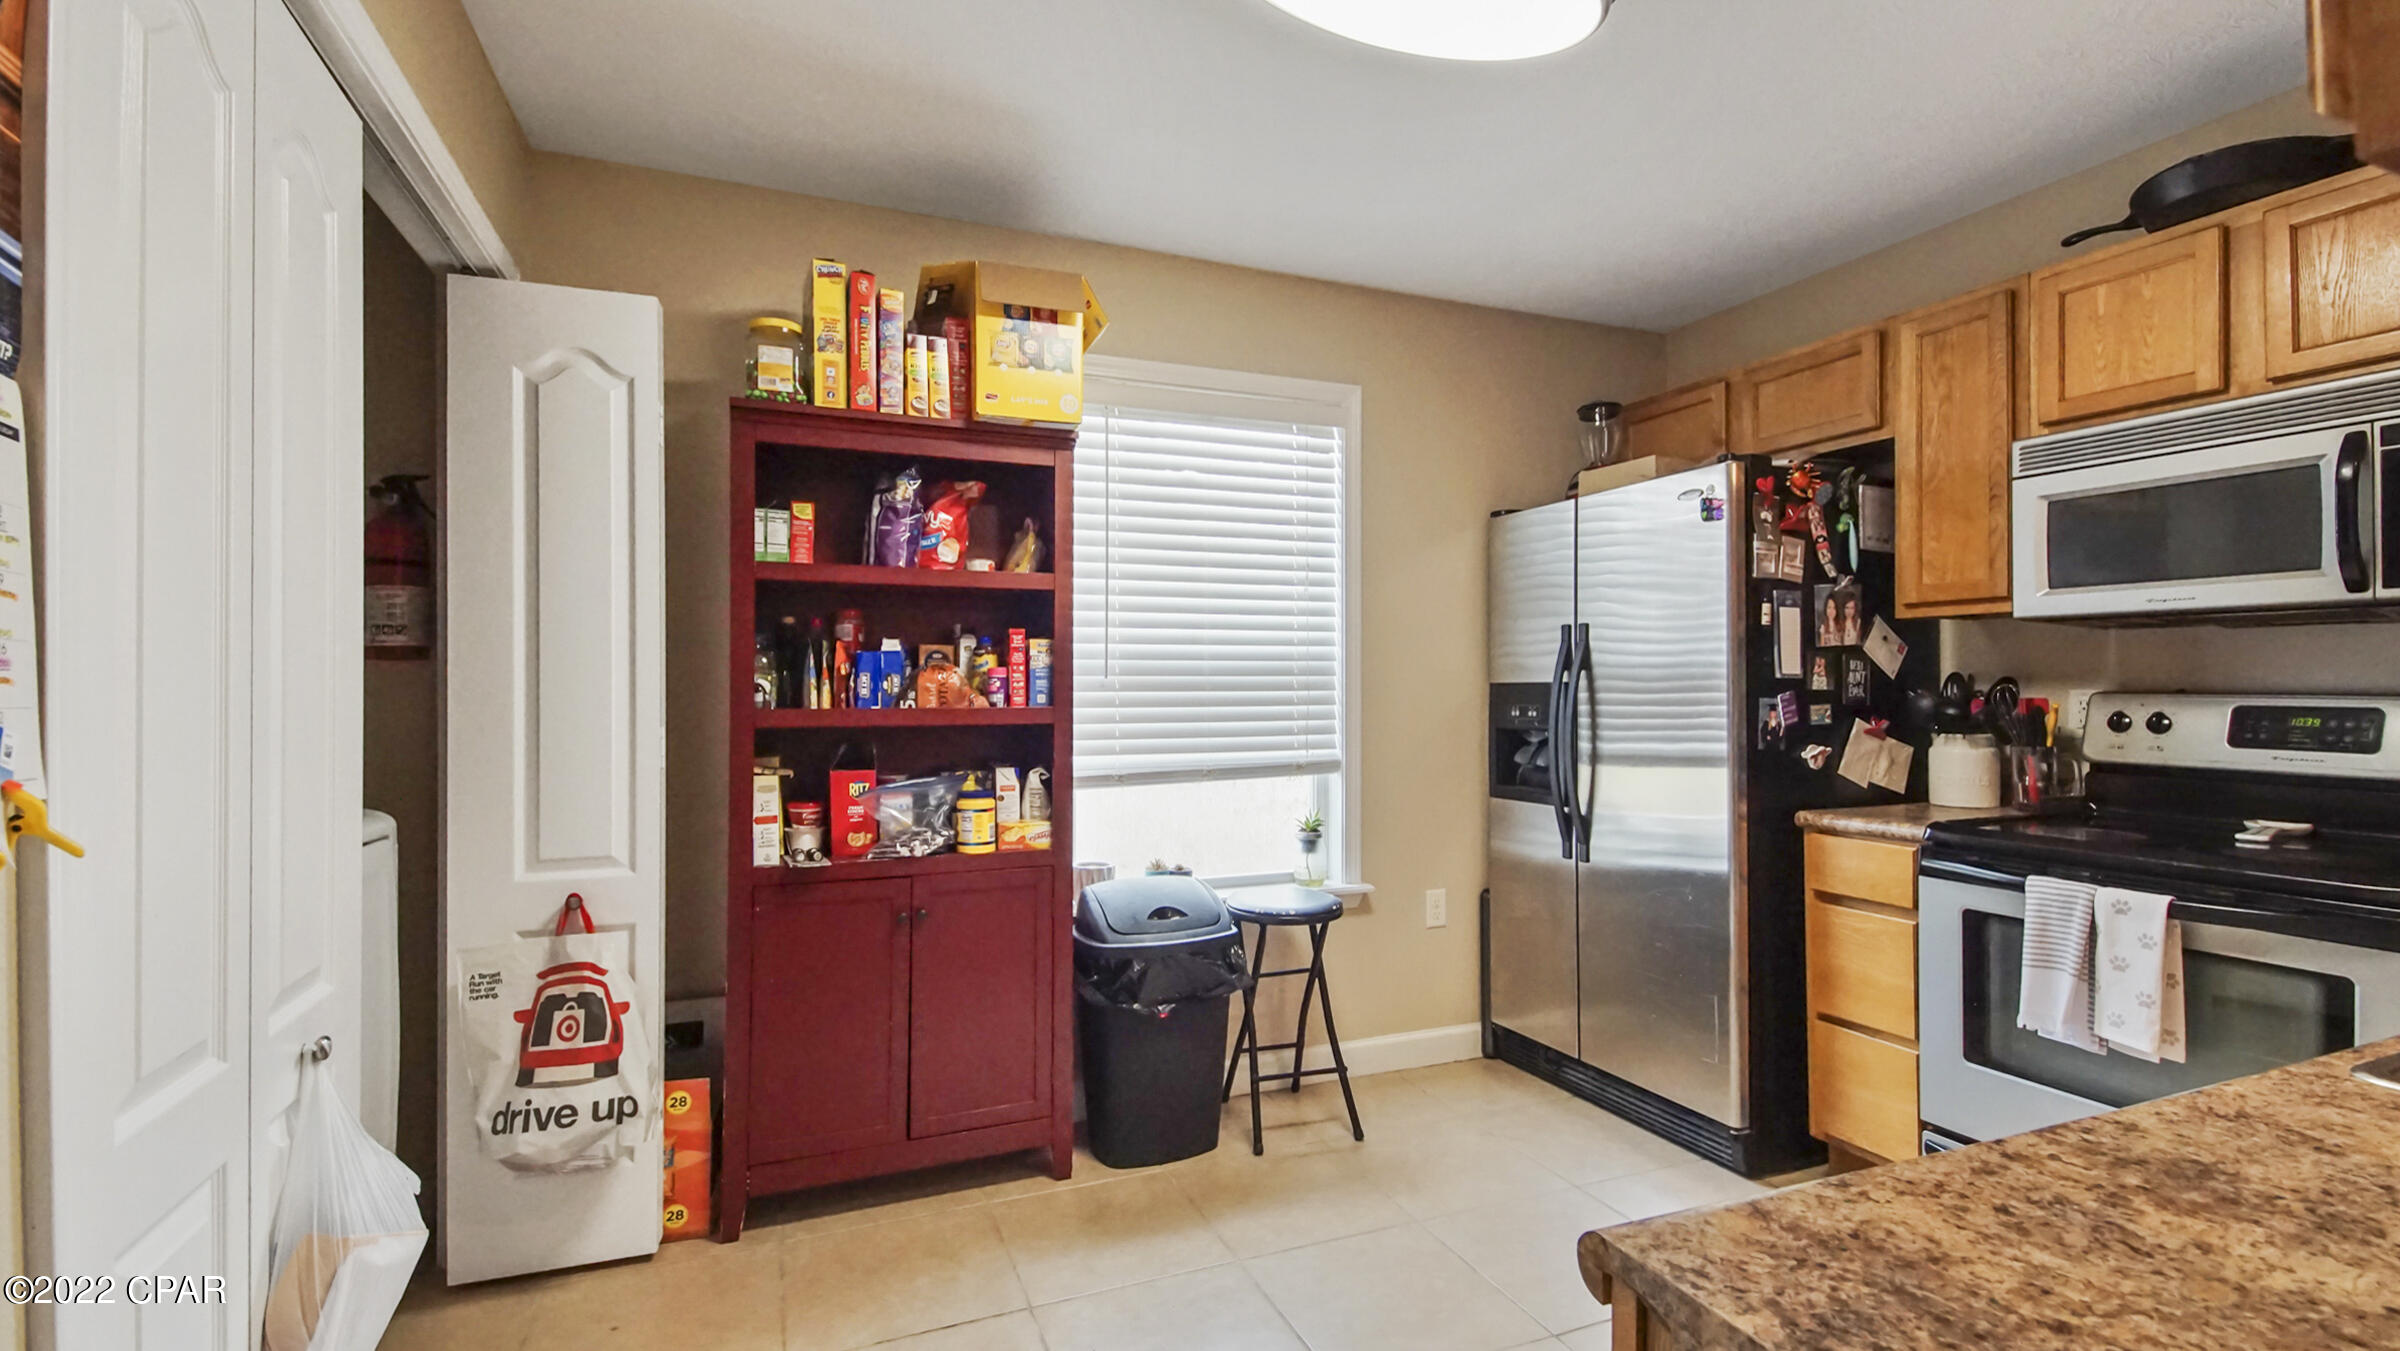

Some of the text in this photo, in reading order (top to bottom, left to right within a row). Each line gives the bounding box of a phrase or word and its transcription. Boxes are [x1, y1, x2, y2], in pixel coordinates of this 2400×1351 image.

[860, 304, 872, 338] FRUITY
[849, 783, 870, 799] RITZ
[478, 971, 501, 980] Target
[670, 1096, 688, 1109] 28
[491, 1095, 639, 1136] drive up
[665, 1210, 684, 1222] 28
